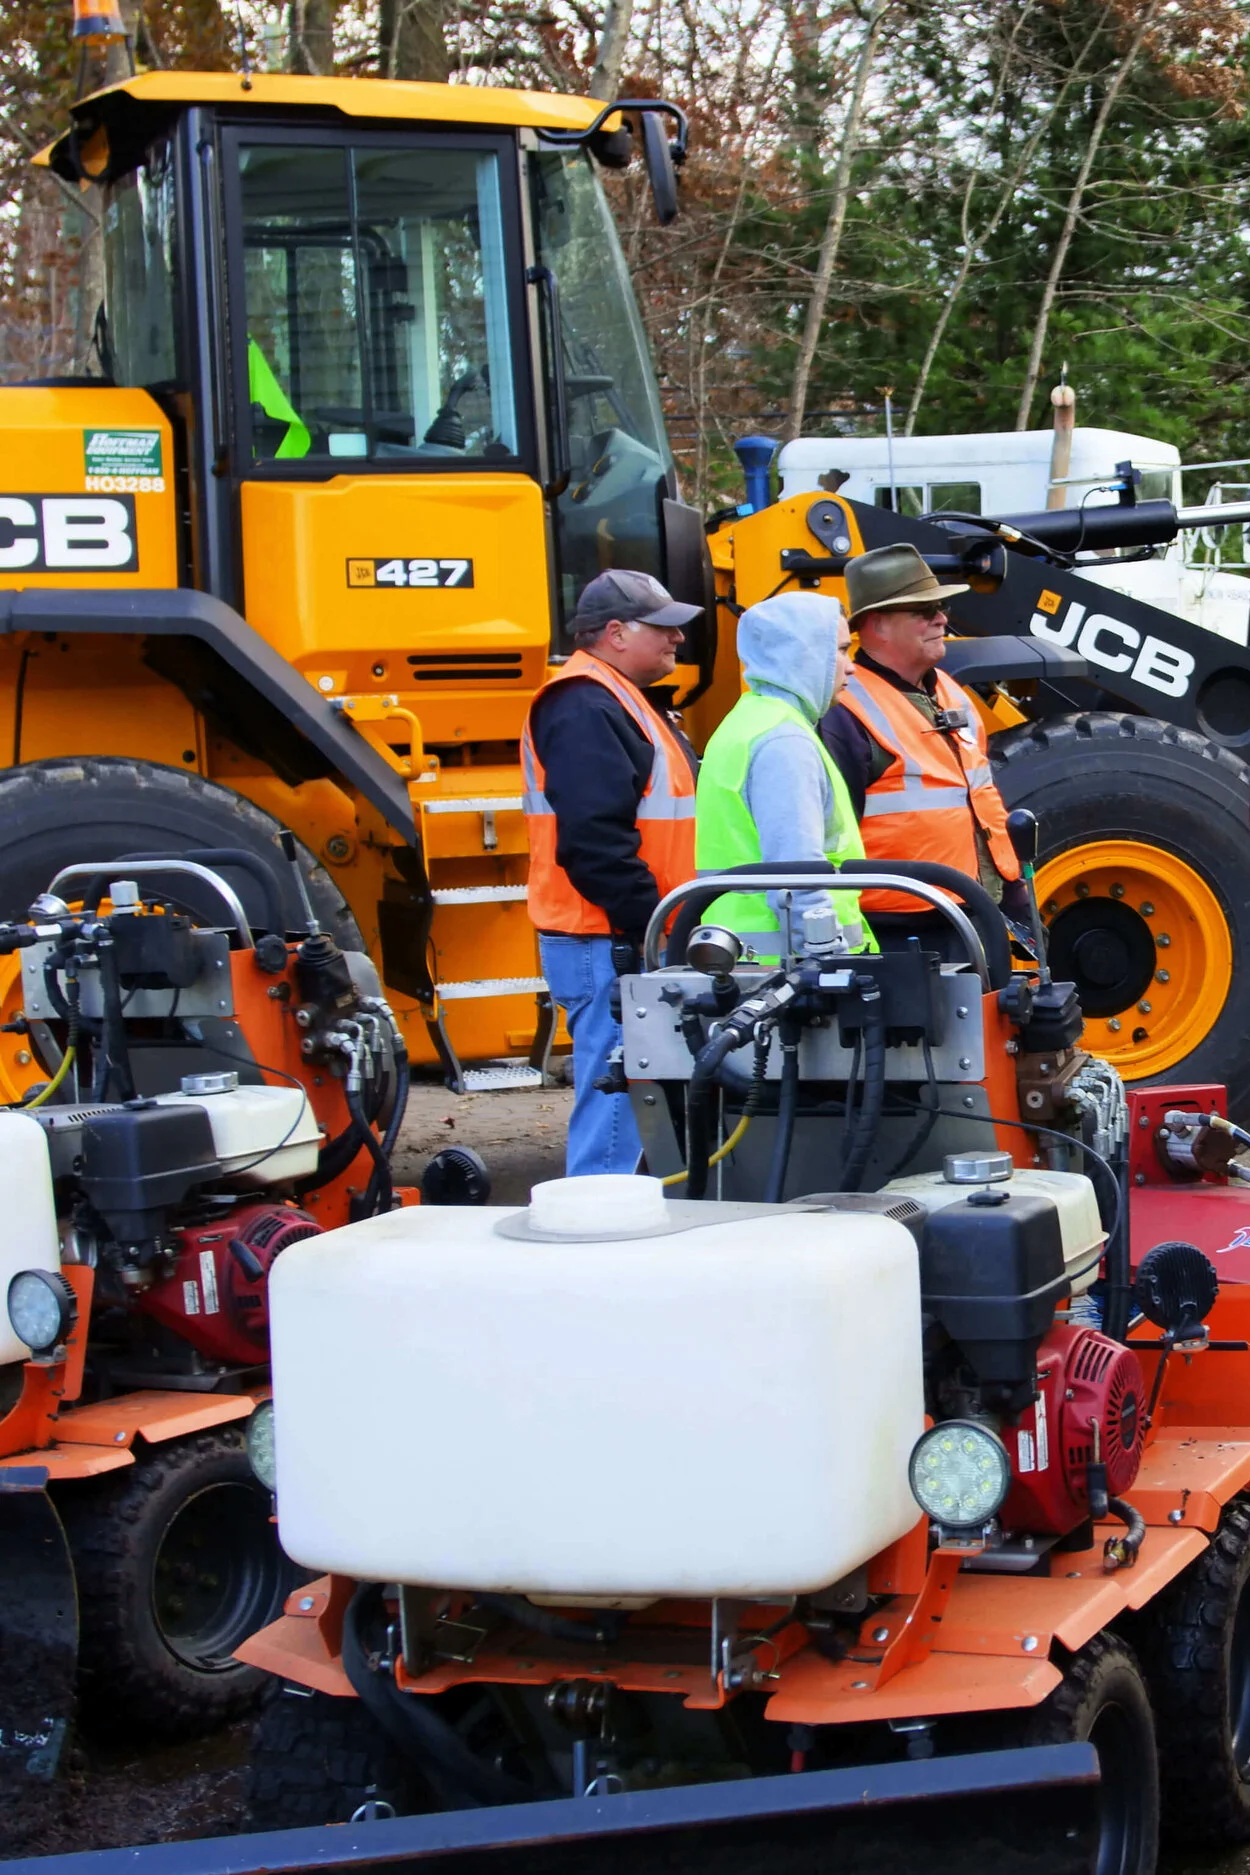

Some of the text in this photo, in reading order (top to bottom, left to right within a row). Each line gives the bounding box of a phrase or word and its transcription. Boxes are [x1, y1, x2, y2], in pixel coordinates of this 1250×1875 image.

[89, 433, 157, 446] HOFFMAN
[376, 559, 468, 586] 427
[1030, 602, 1195, 698] JCB
